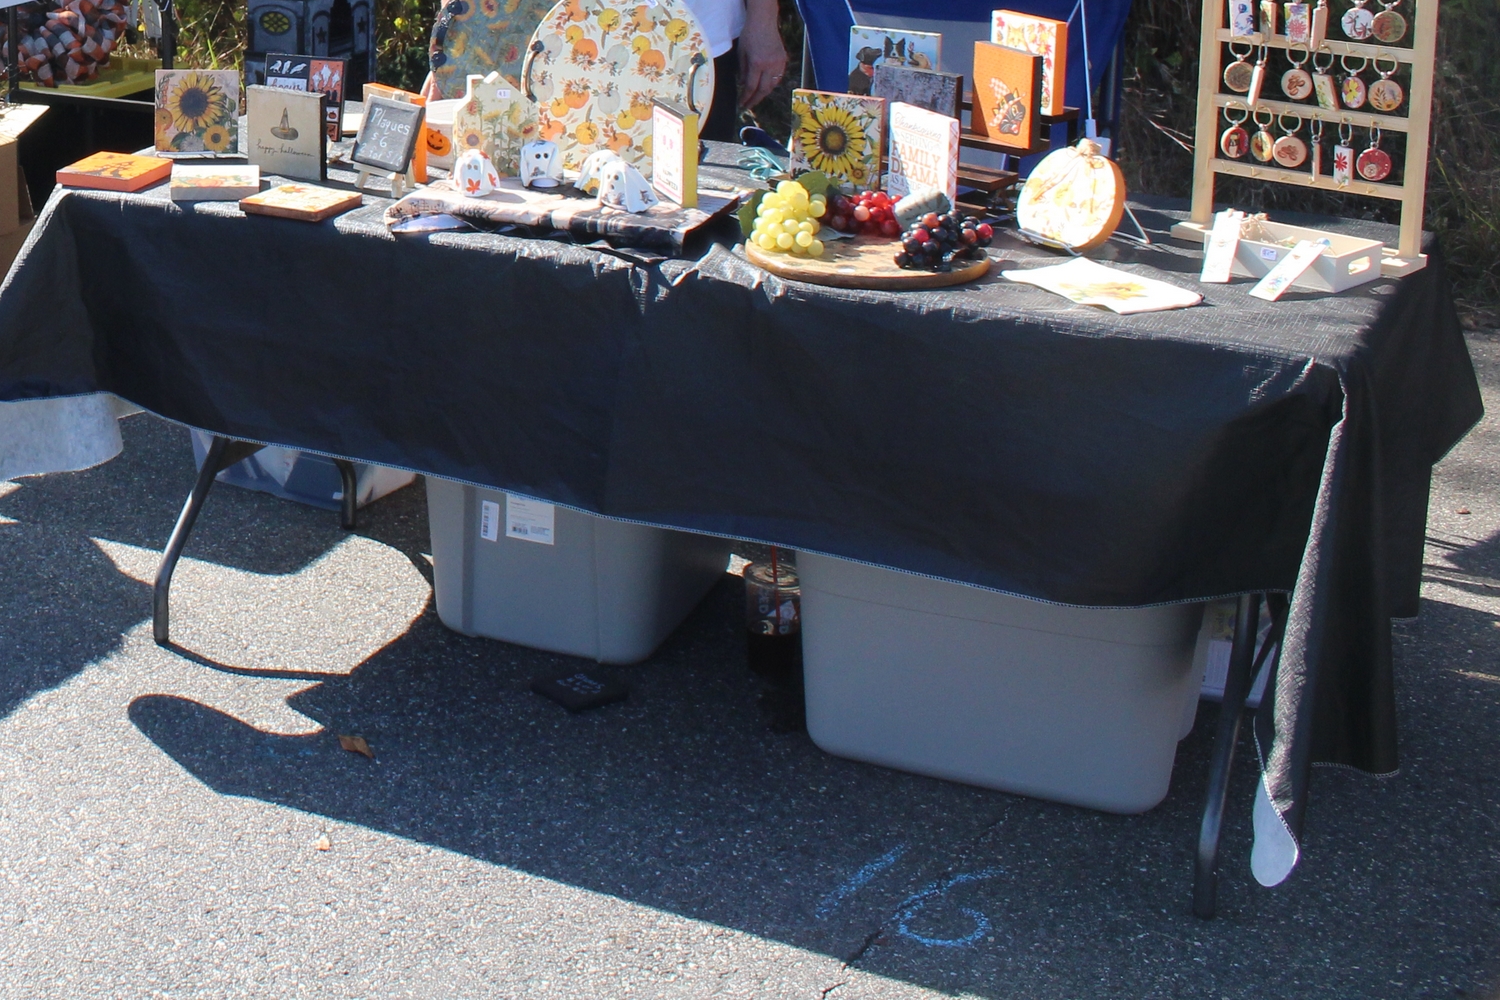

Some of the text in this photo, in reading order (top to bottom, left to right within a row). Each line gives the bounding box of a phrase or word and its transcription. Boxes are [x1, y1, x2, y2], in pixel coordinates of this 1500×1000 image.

[370, 107, 411, 136] Plaques
[256, 138, 315, 157] happy halloween
[891, 140, 941, 171] FAMILY
[900, 131, 934, 151] SERVING
[891, 156, 940, 190] DRAMA
[815, 844, 1008, 947] 16
